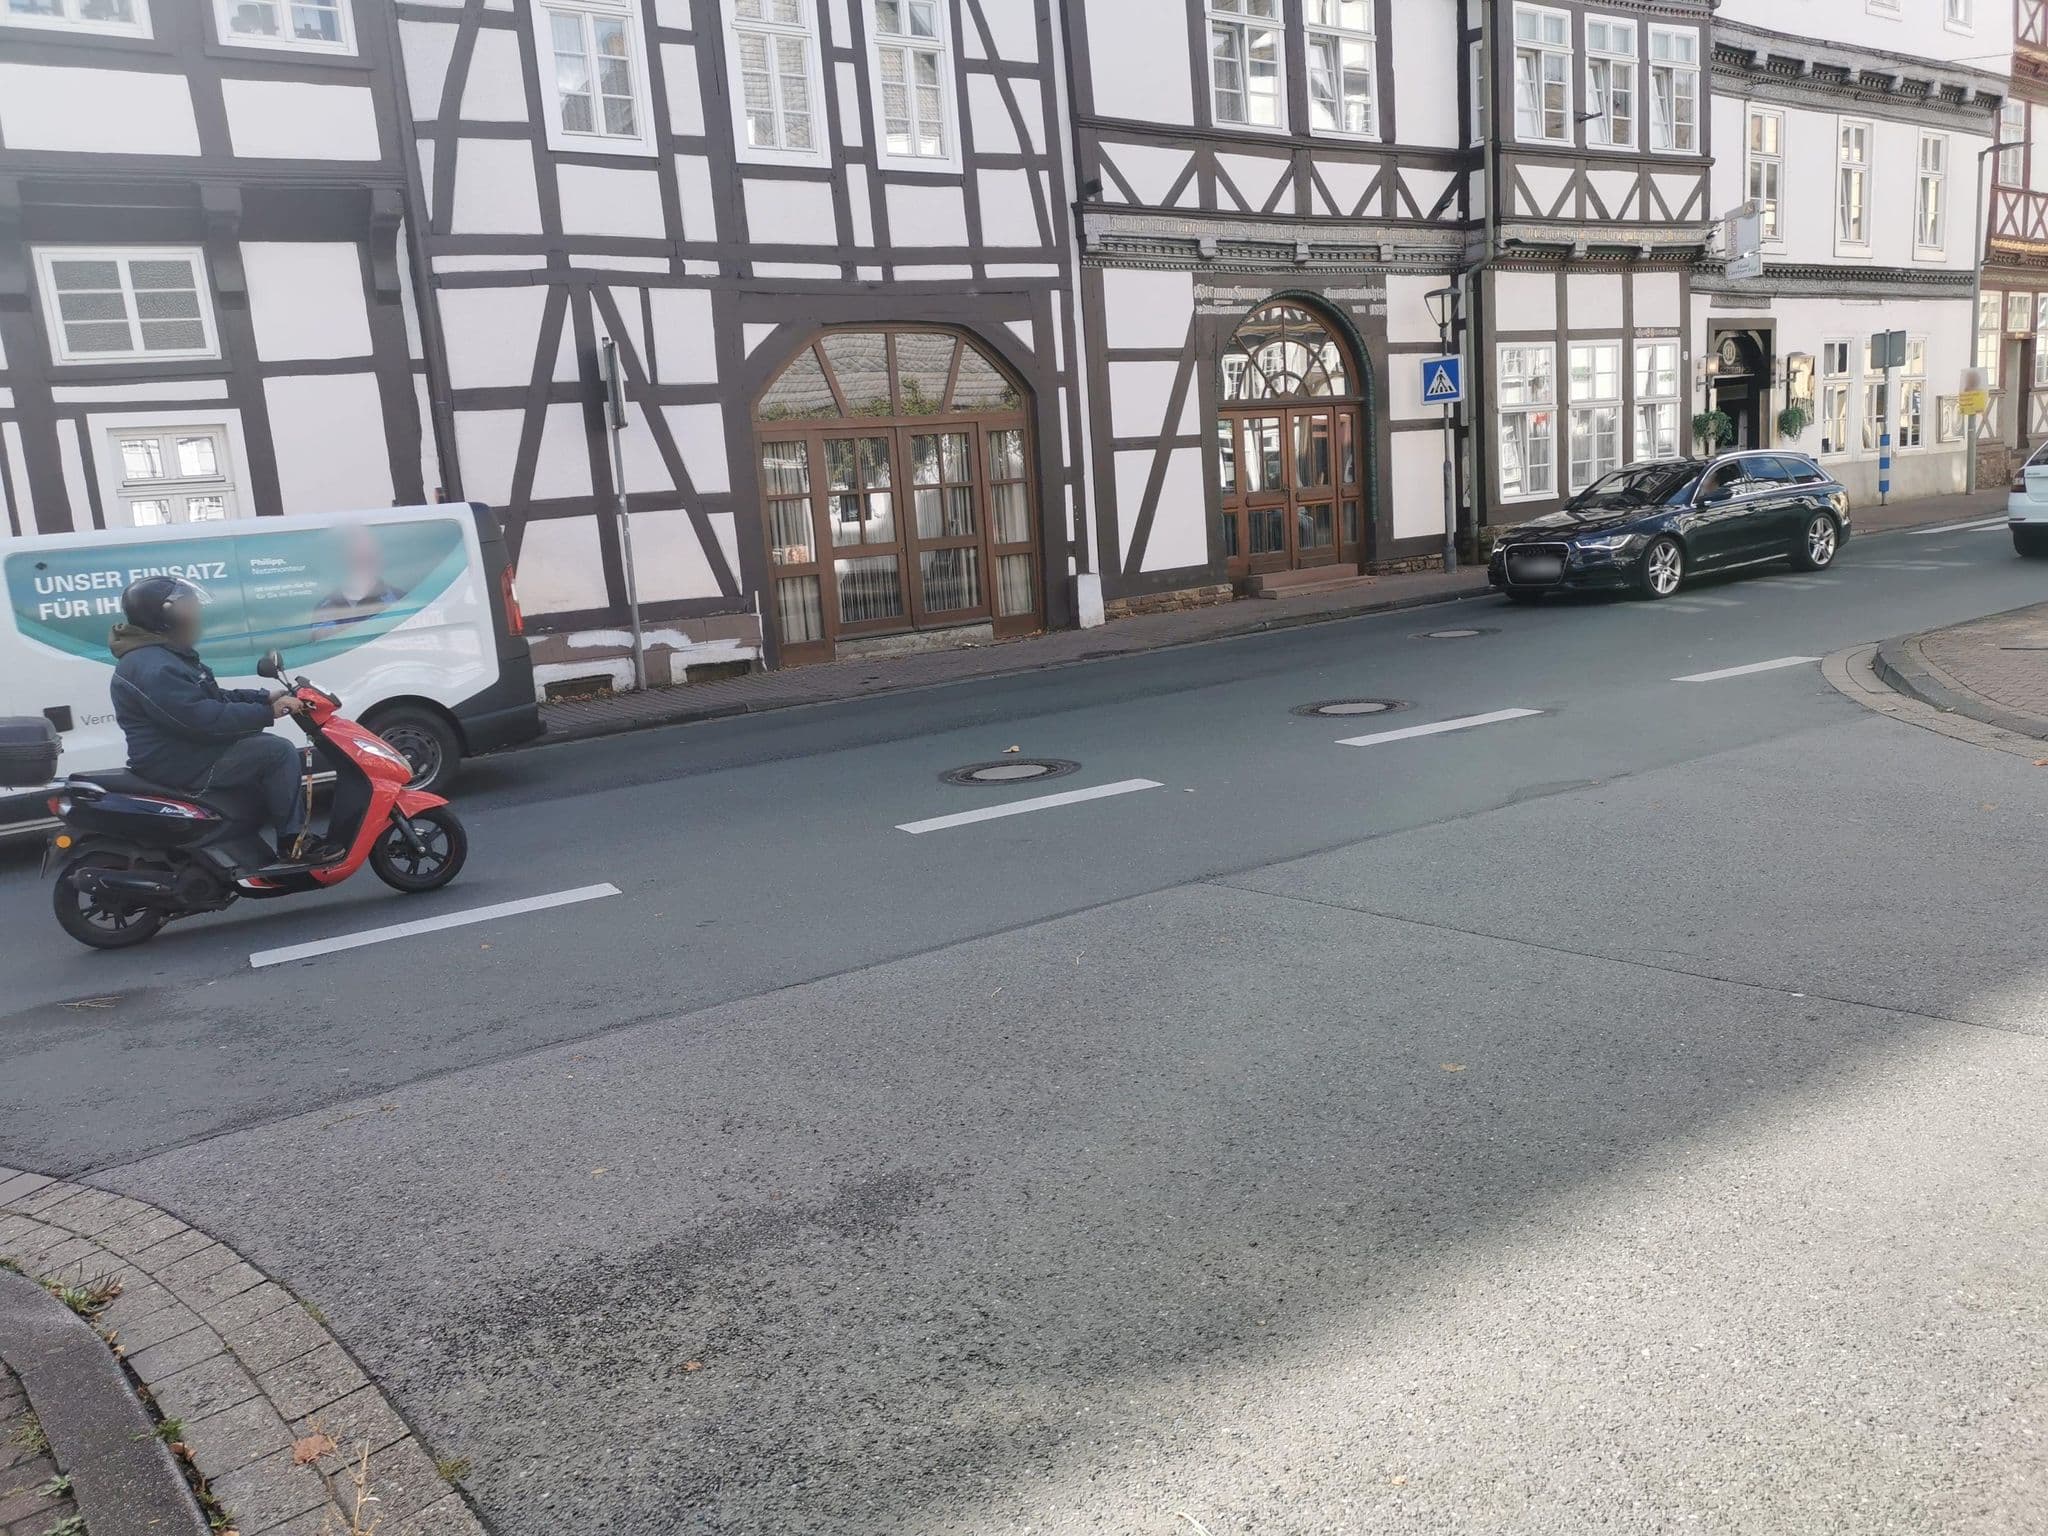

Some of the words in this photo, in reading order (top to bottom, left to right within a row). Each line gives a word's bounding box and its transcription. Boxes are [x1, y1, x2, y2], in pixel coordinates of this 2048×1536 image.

[35, 571, 123, 594] UNSER
[38, 598, 91, 621] FÜR
[95, 597, 123, 615] IH
[80, 714, 115, 726] Vern
